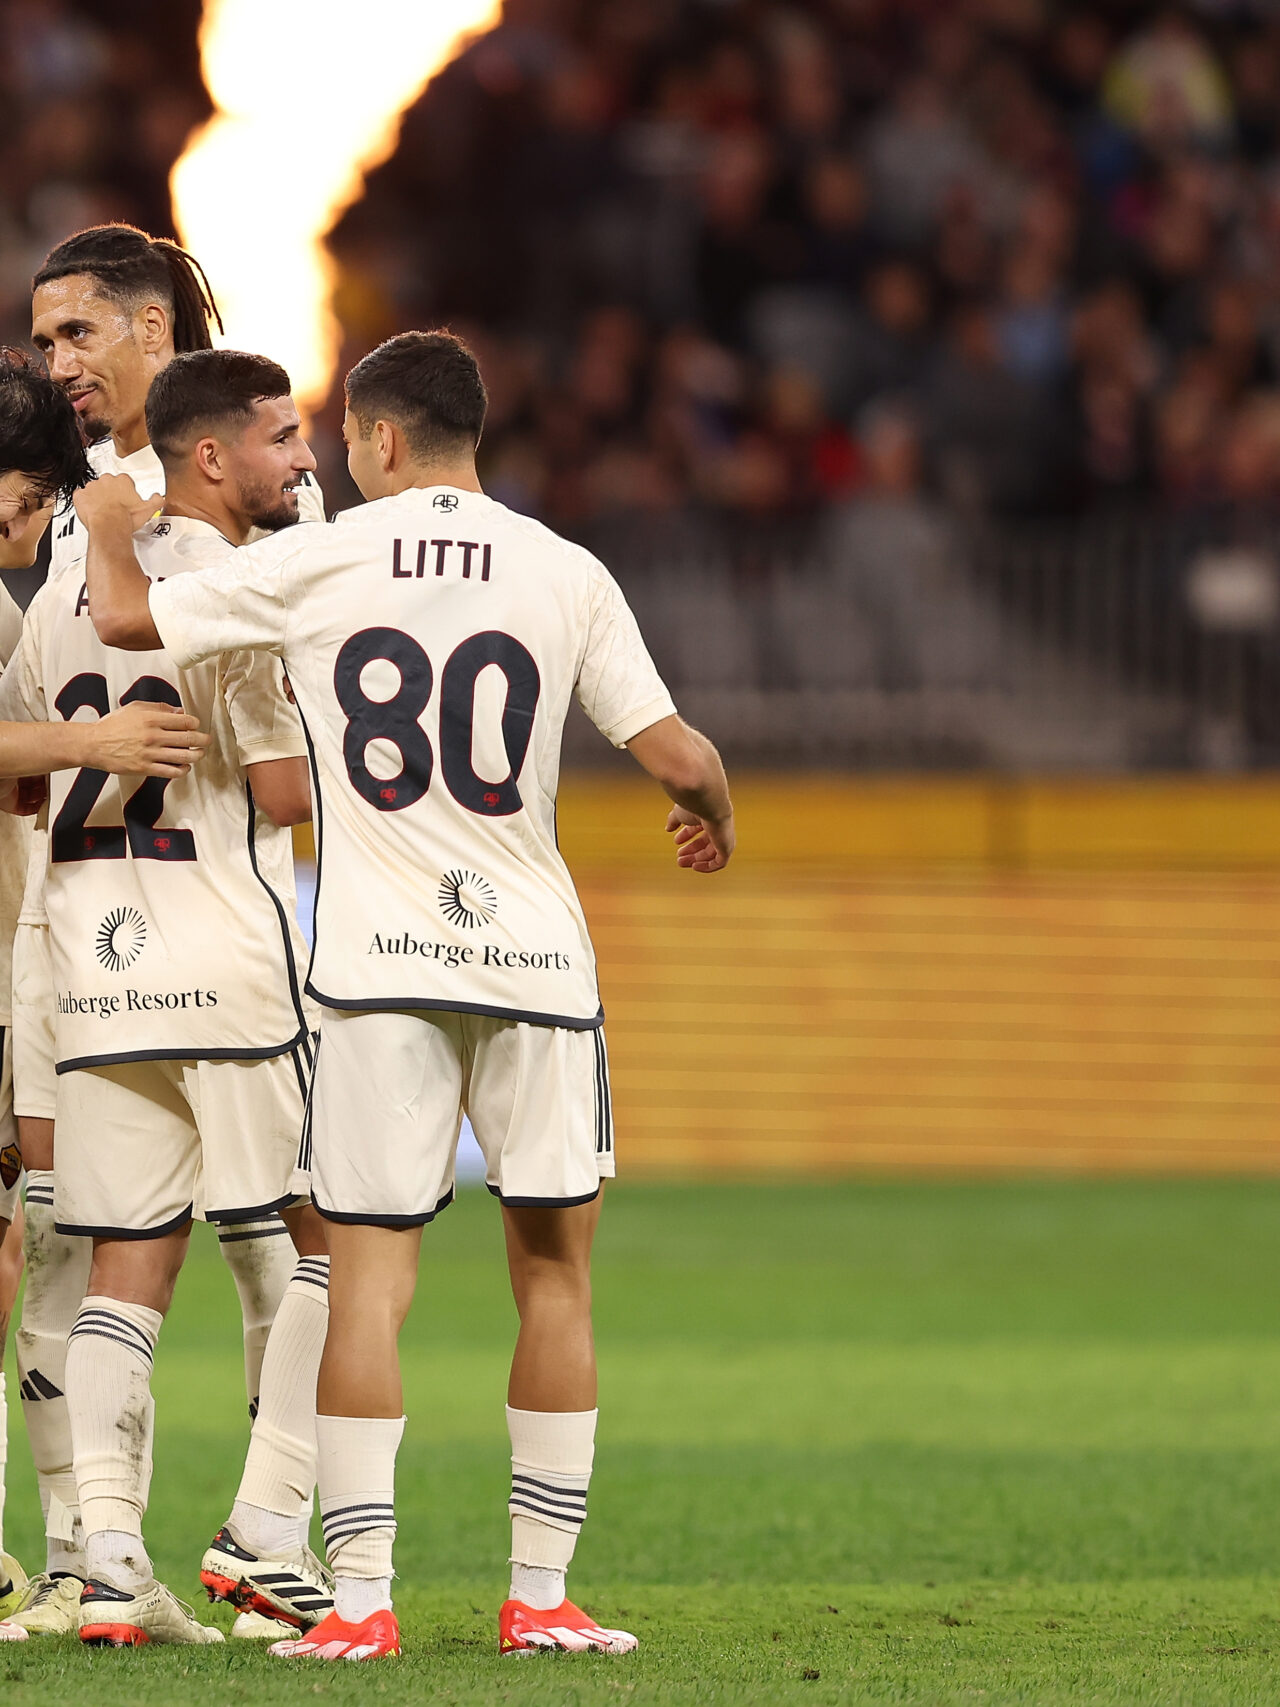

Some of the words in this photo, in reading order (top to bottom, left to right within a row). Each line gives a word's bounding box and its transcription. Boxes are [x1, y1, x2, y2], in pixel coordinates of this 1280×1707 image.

[392, 538, 492, 582] LITTI
[333, 626, 541, 817] 80
[51, 672, 198, 864] 22
[368, 931, 475, 969] Auberge
[481, 945, 570, 971] Resorts
[124, 988, 218, 1012] Resorts
[146, 1598, 161, 1609] COPA
